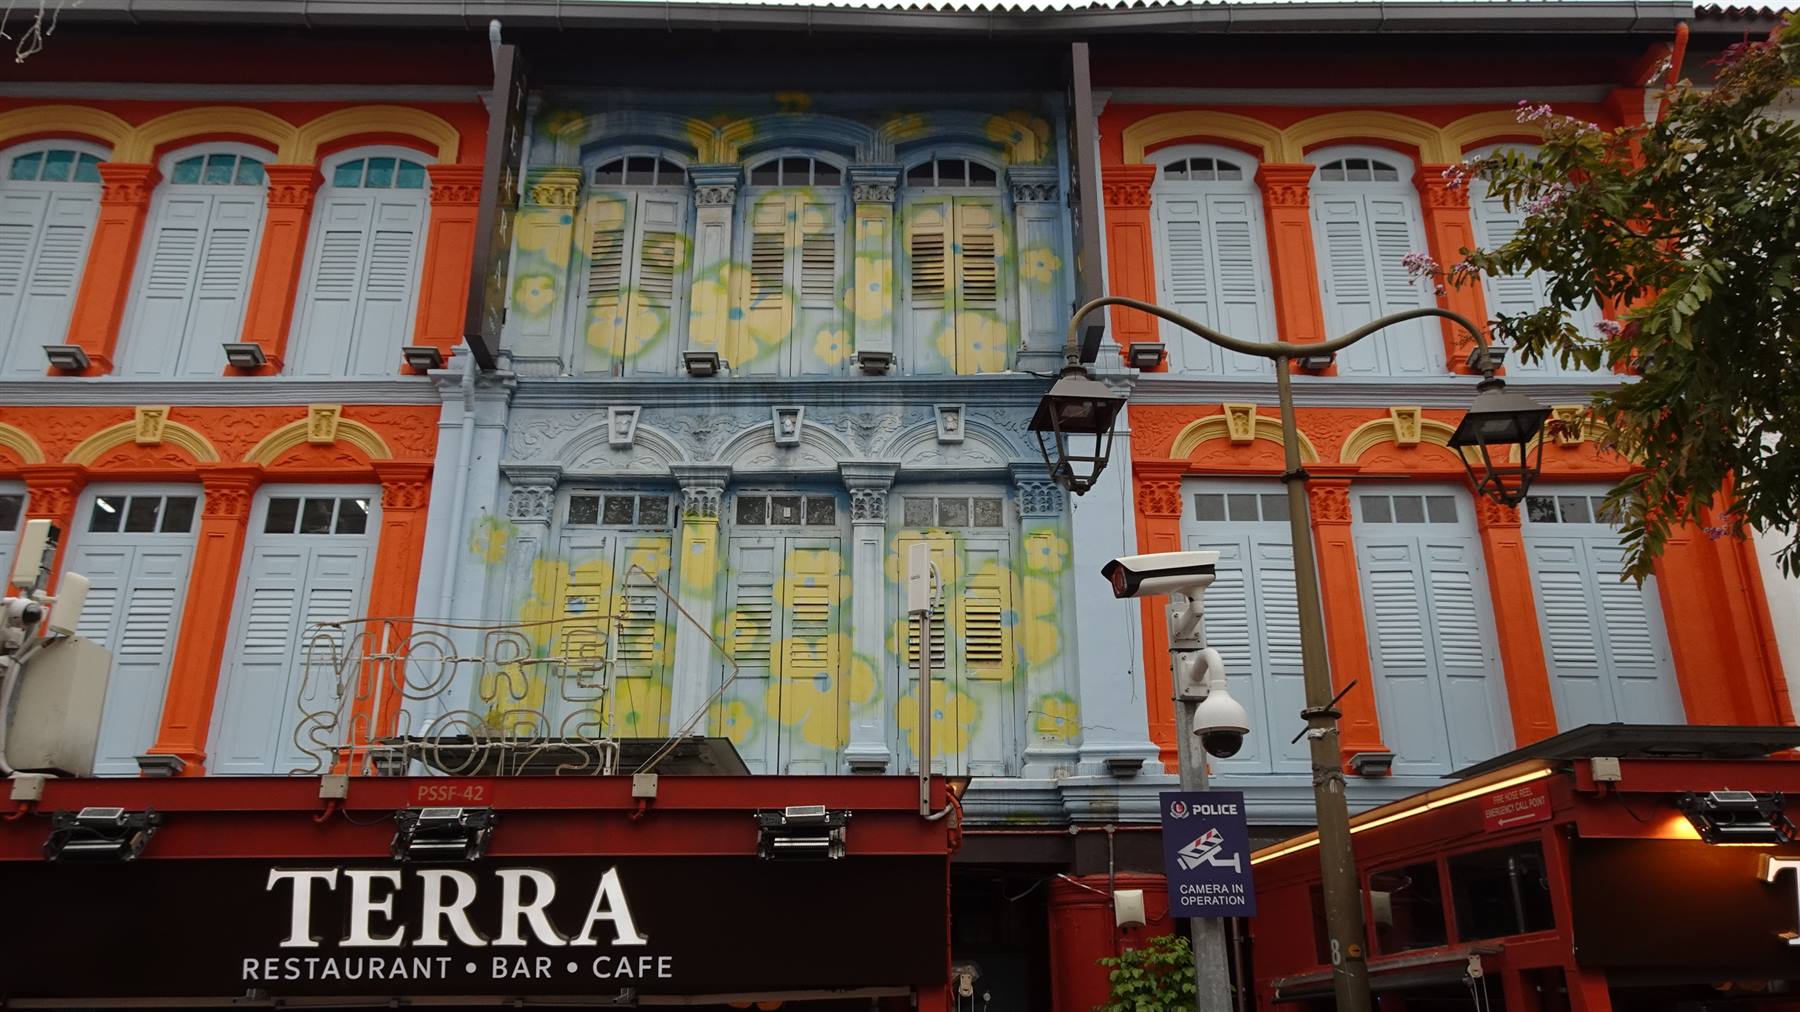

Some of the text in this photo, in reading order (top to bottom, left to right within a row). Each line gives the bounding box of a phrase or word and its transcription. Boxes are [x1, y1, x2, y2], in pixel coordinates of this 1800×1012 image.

[300, 629, 609, 702] MORE
[417, 785, 485, 801] PSSF-42
[1192, 804, 1238, 816] POLICE
[1515, 800, 1529, 812] CALL
[1530, 795, 1545, 809] POINT
[1179, 884, 1244, 895] CAMERA IN
[265, 866, 649, 949] TERRA
[1180, 895, 1245, 906] OPERATION
[1330, 938, 1341, 966] 8
[242, 955, 673, 980] RESTAURANT BAR CAFE
